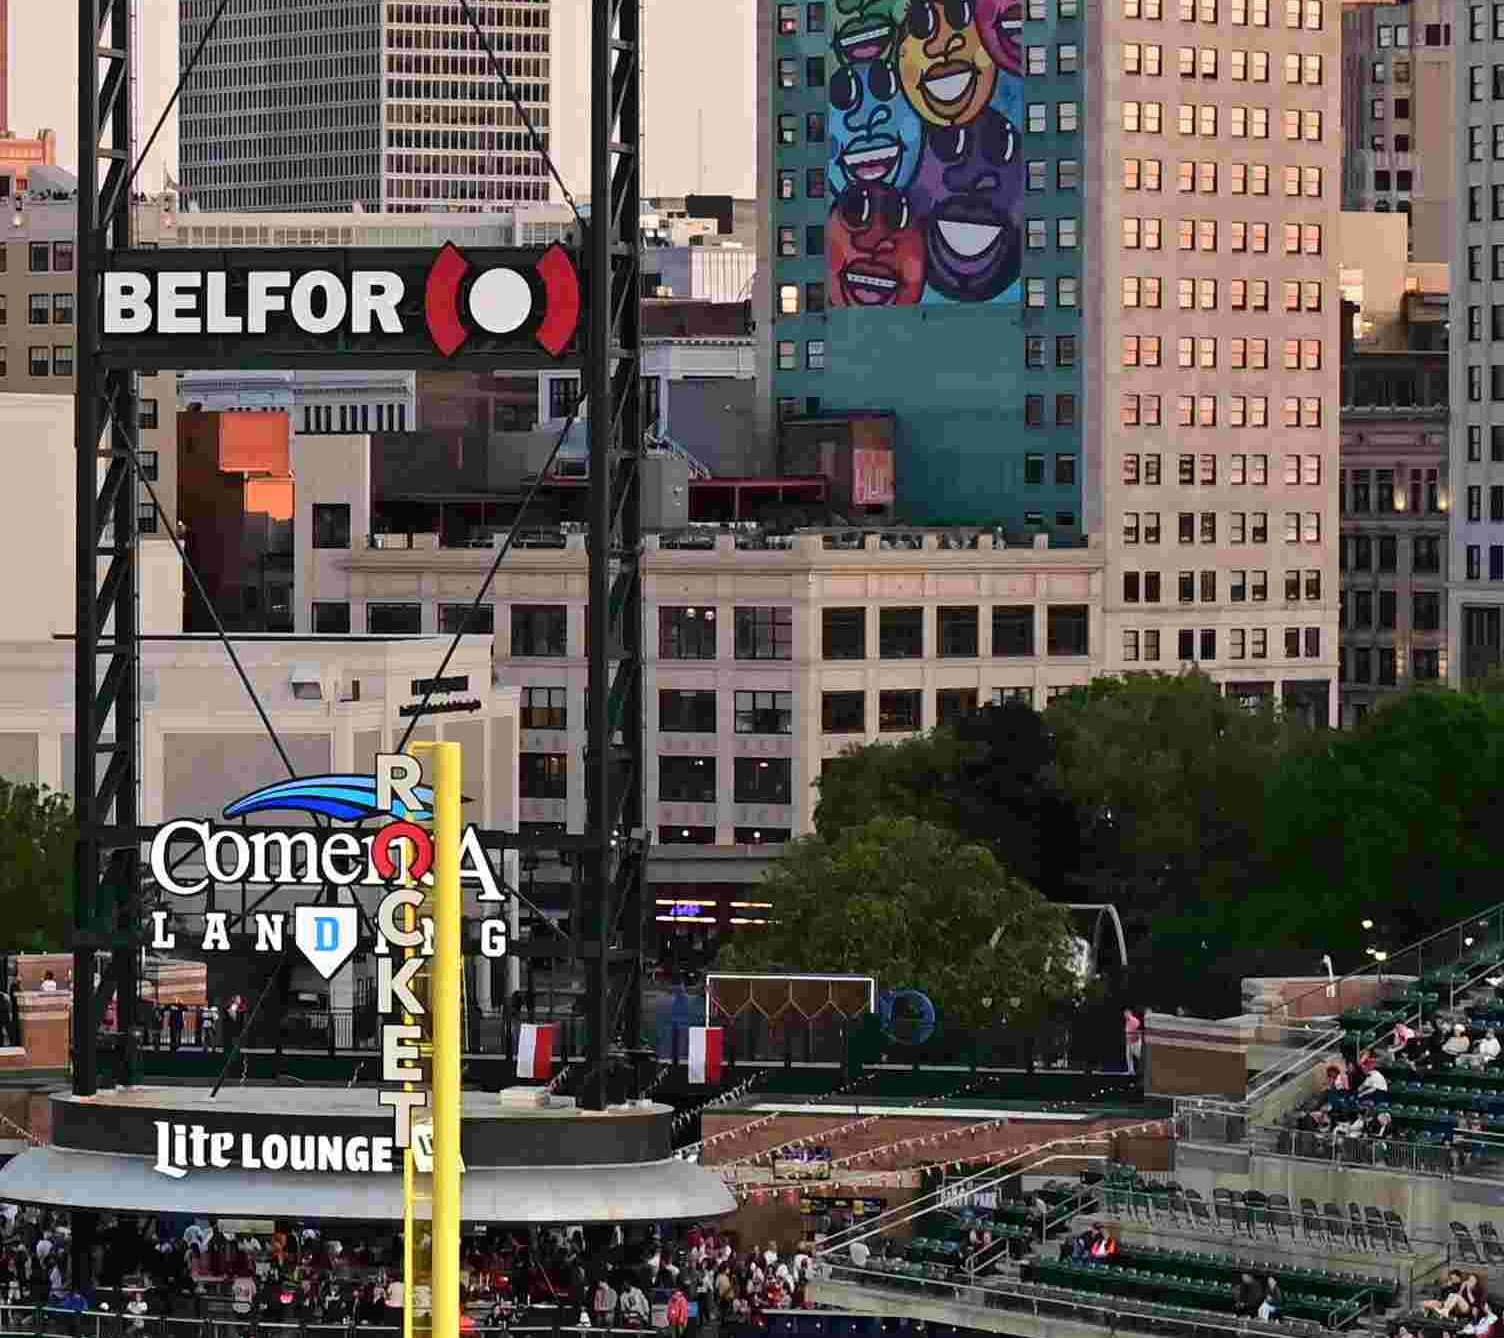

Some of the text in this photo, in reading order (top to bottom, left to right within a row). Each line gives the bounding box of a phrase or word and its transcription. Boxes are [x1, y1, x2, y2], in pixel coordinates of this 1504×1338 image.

[103, 269, 405, 334] BELFOR
[153, 1120, 234, 1179] Lite
[242, 1133, 394, 1173] LOUNGE
